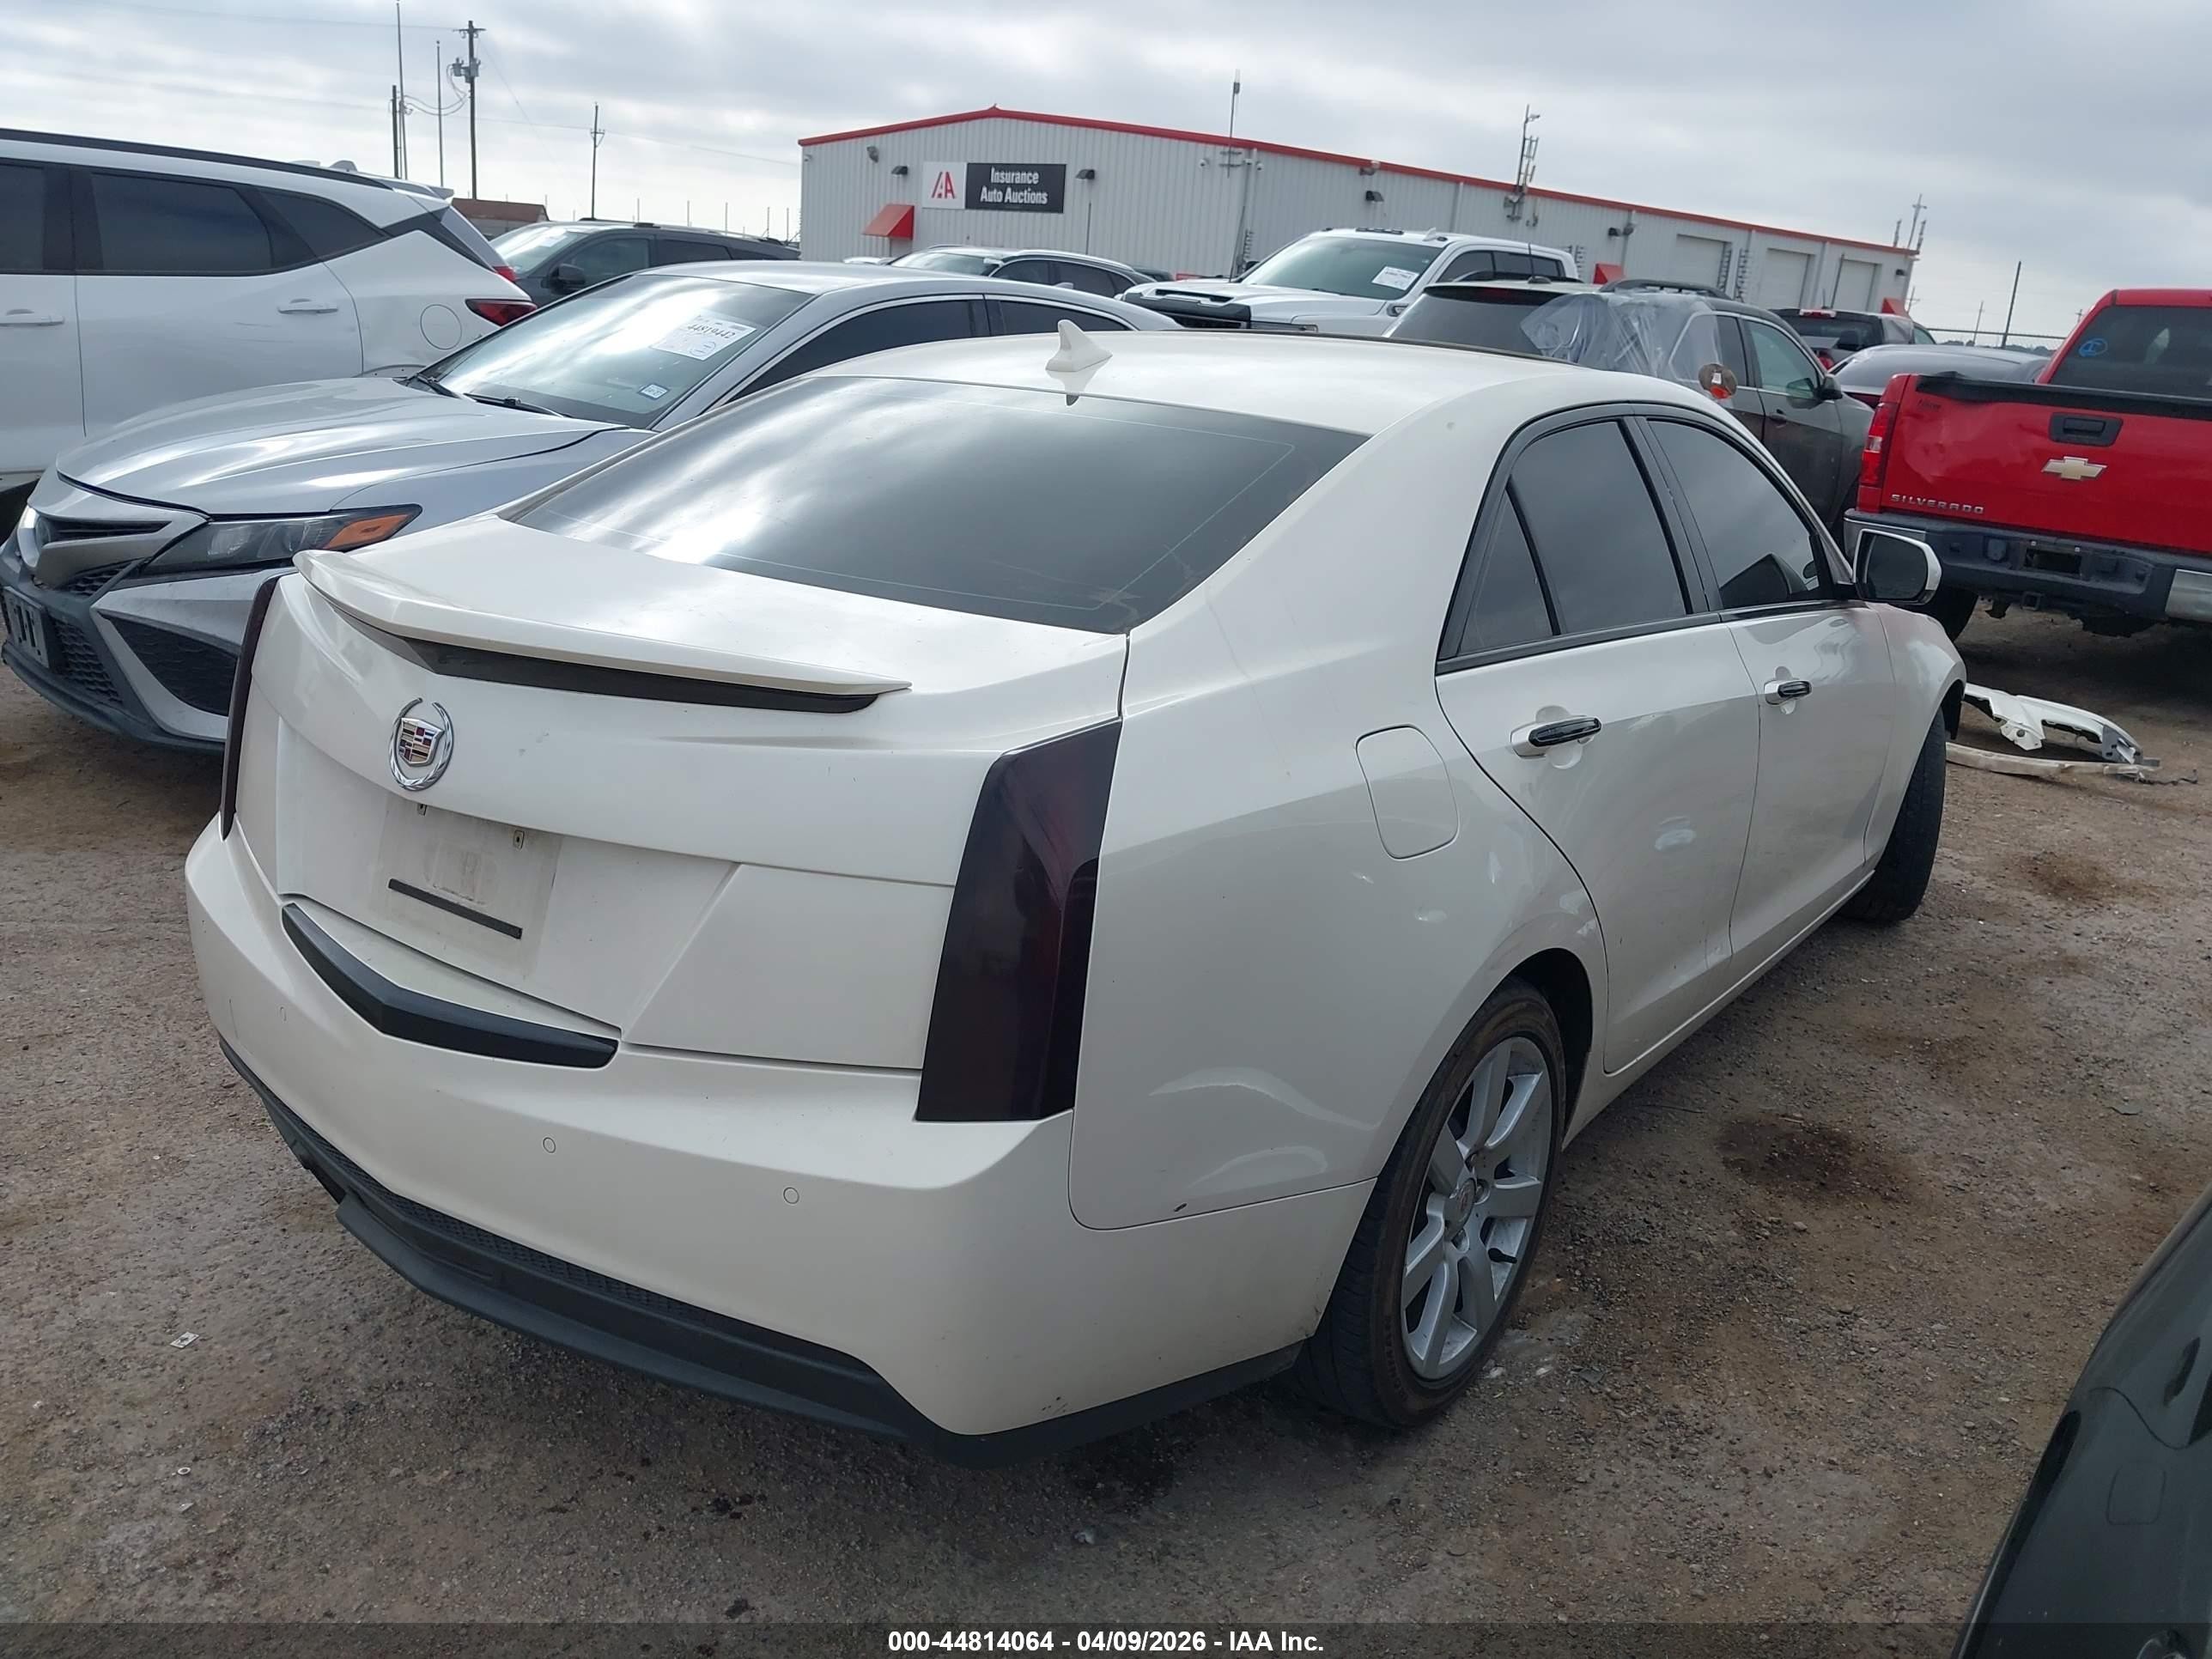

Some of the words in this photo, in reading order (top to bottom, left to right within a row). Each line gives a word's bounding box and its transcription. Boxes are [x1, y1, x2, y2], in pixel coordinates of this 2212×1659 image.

[990, 167, 1039, 185] Insurance
[980, 185, 1002, 203] Auto
[1004, 186, 1048, 204] Auctions
[1892, 494, 1984, 514] SILVERADO
